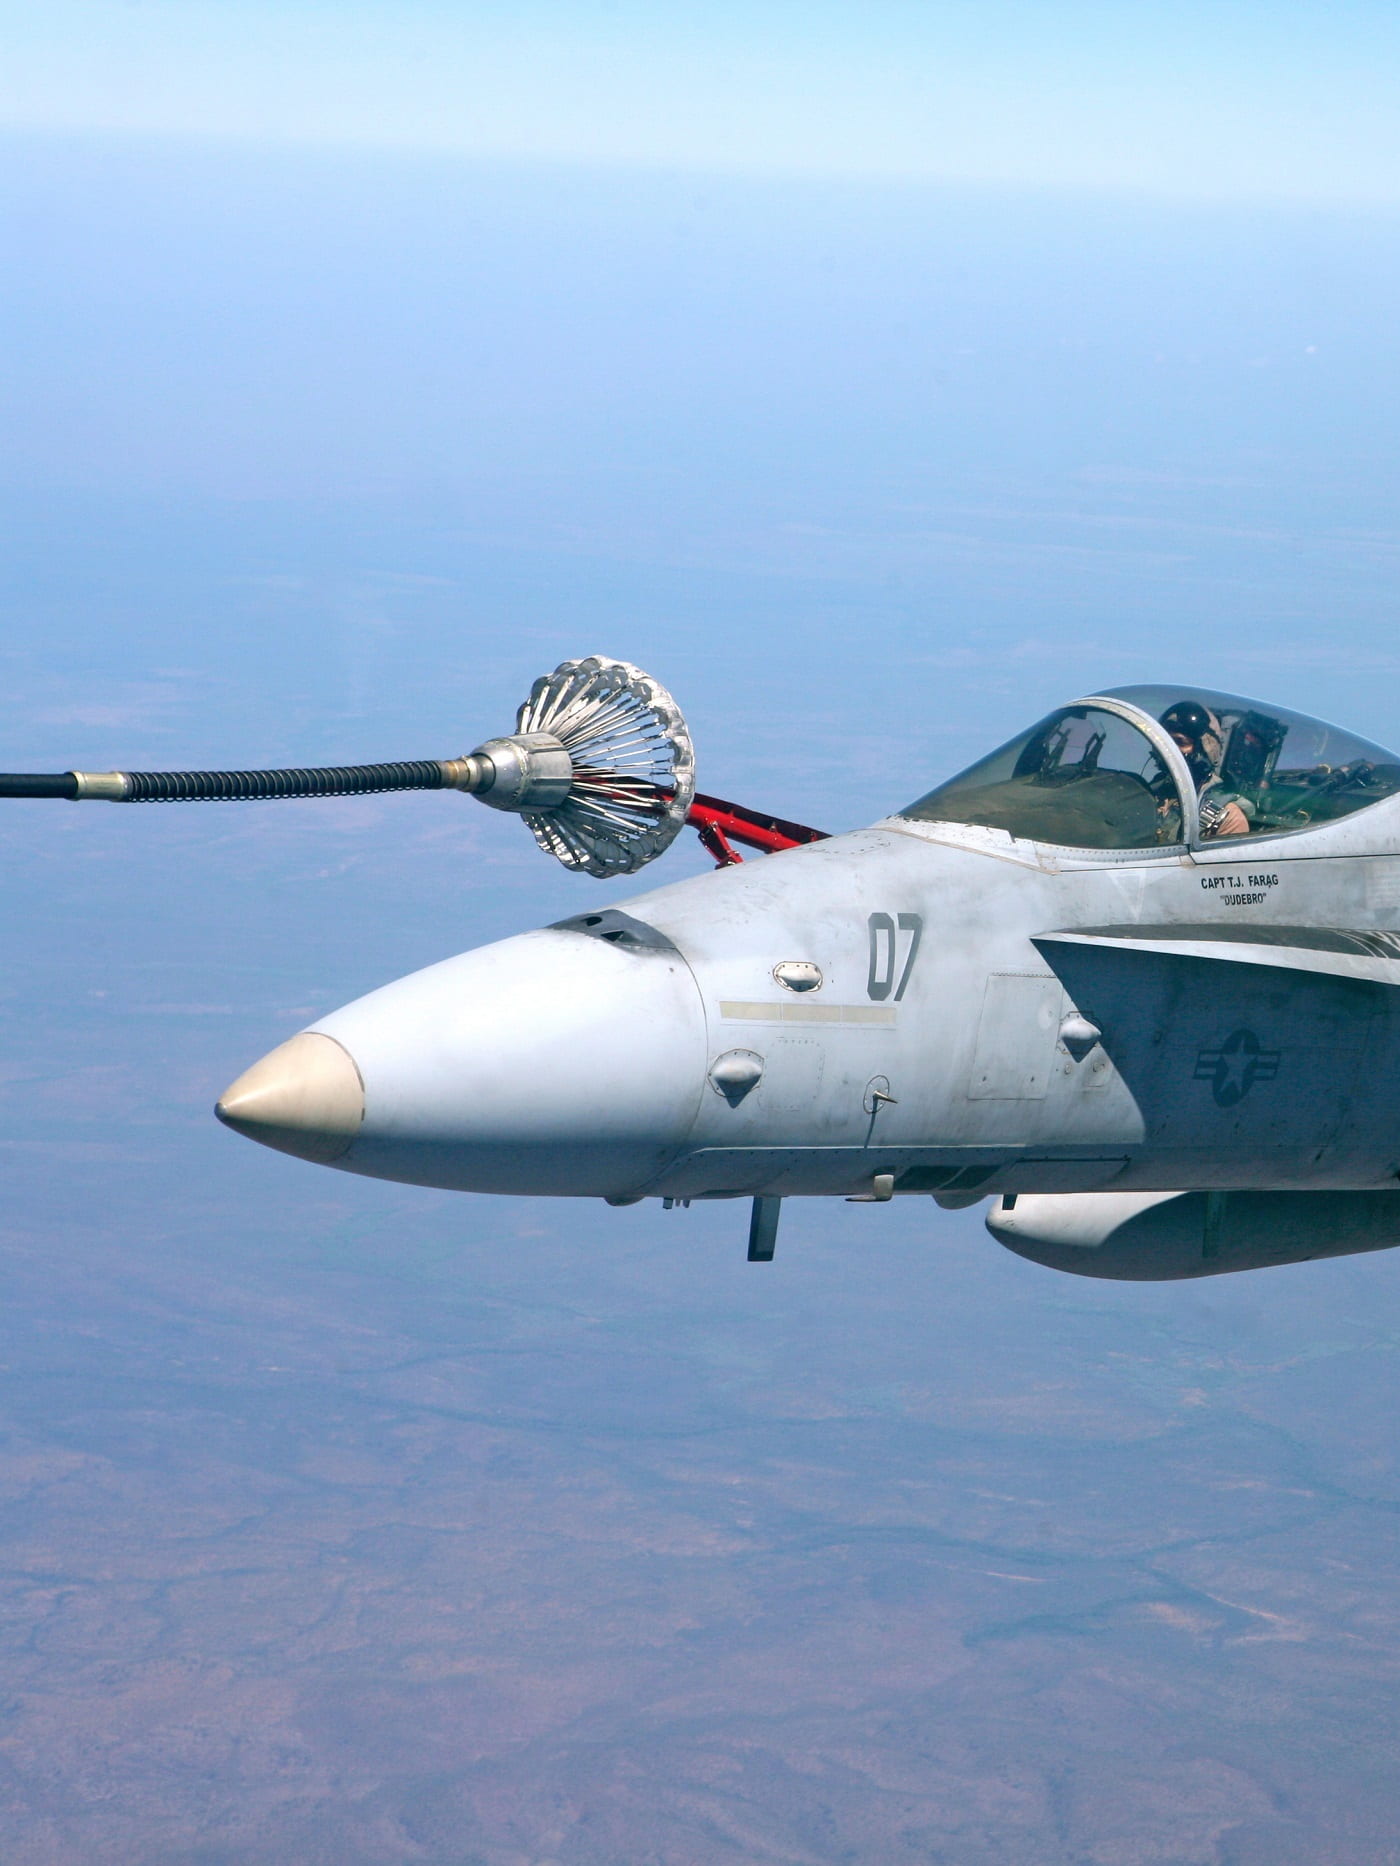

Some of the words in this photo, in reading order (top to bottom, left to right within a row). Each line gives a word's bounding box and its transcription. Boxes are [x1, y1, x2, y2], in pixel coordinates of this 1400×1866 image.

[1200, 877, 1225, 889] CAPT
[1227, 876, 1244, 888] T.J.
[1248, 874, 1279, 887] FARAG
[1220, 892, 1267, 906] "DUDEBRO"
[867, 912, 923, 1001] 07
